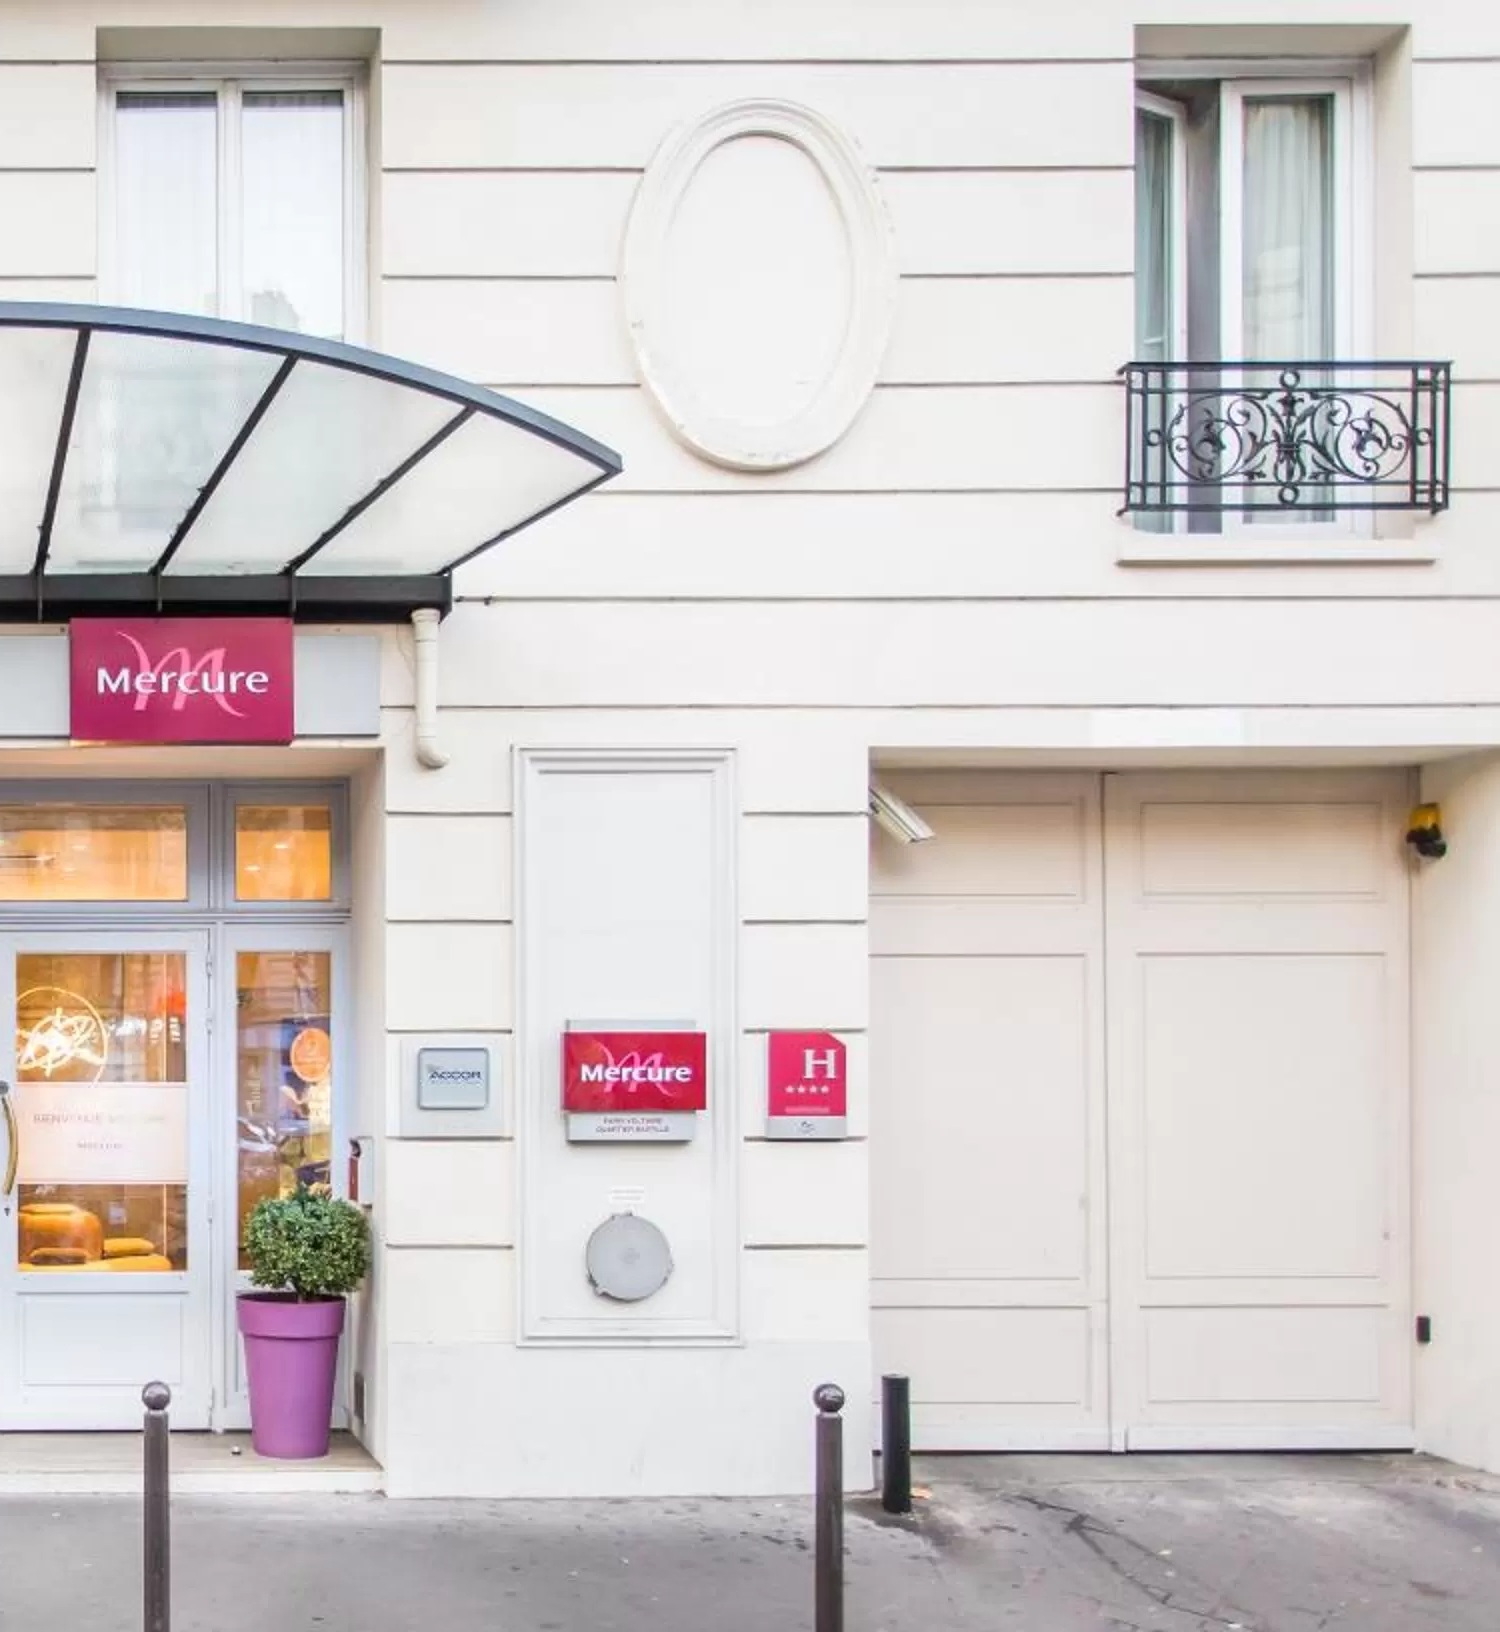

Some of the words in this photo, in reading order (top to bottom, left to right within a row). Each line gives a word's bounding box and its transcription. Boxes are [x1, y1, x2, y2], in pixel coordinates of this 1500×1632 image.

[97, 666, 269, 694] Mercure
[580, 1063, 693, 1083] Mercure
[803, 1048, 837, 1080] H
